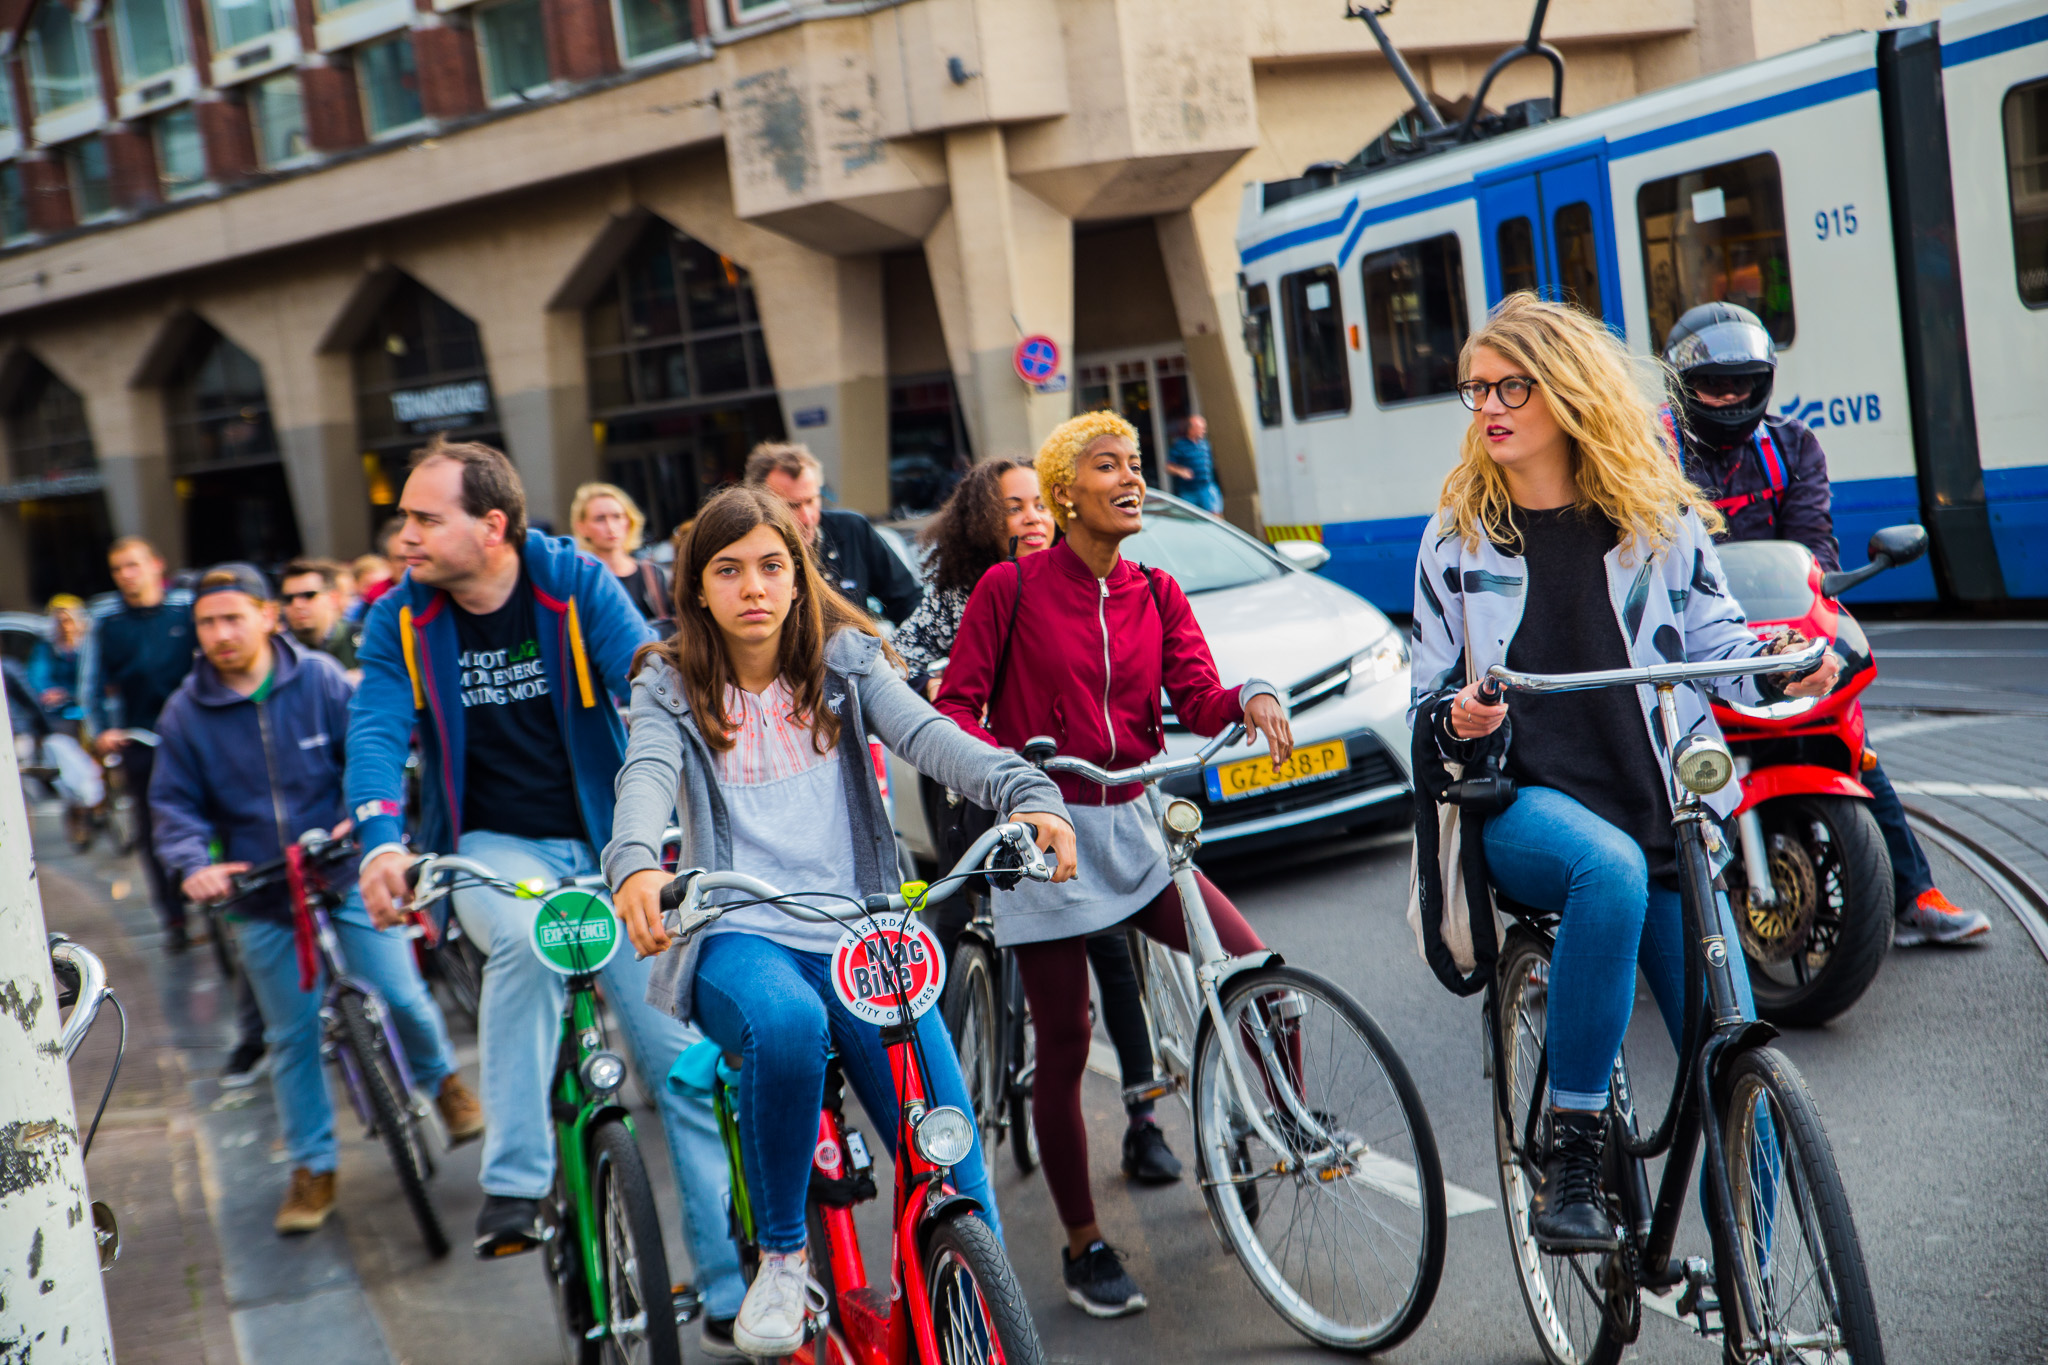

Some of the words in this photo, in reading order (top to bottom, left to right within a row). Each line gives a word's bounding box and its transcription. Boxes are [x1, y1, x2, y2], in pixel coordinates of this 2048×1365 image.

[1815, 204, 1858, 241] 915
[1829, 394, 1881, 426] GVB
[865, 937, 924, 969] Mac
[853, 965, 913, 1000] Bike
[855, 1001, 880, 1018] CITY
